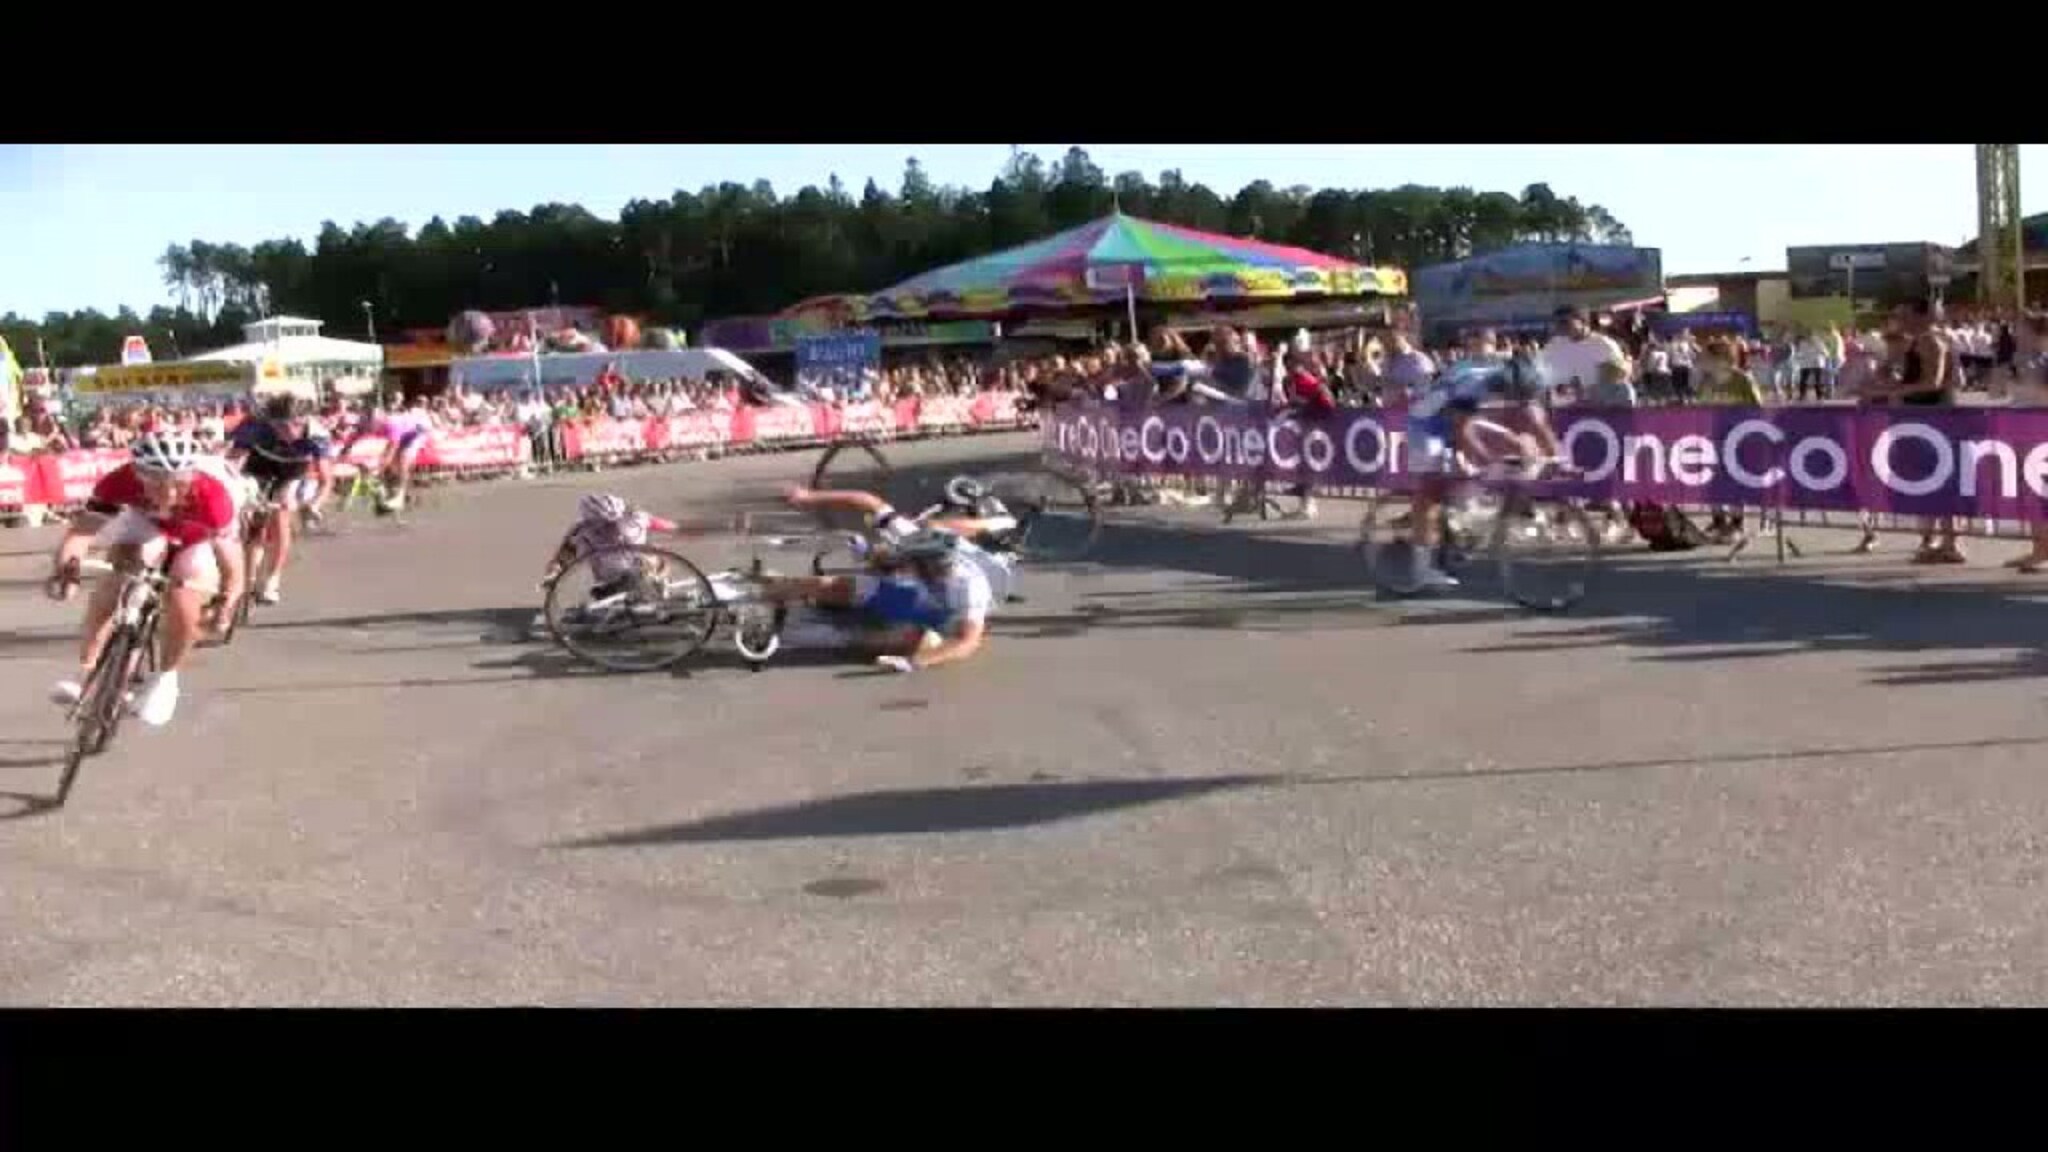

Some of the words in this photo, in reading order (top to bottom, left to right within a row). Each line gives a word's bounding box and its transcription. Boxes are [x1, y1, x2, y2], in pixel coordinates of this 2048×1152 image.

[1197, 415, 1334, 472] OneCo
[1562, 418, 1848, 491] OneCo
[1871, 423, 2048, 500] One
